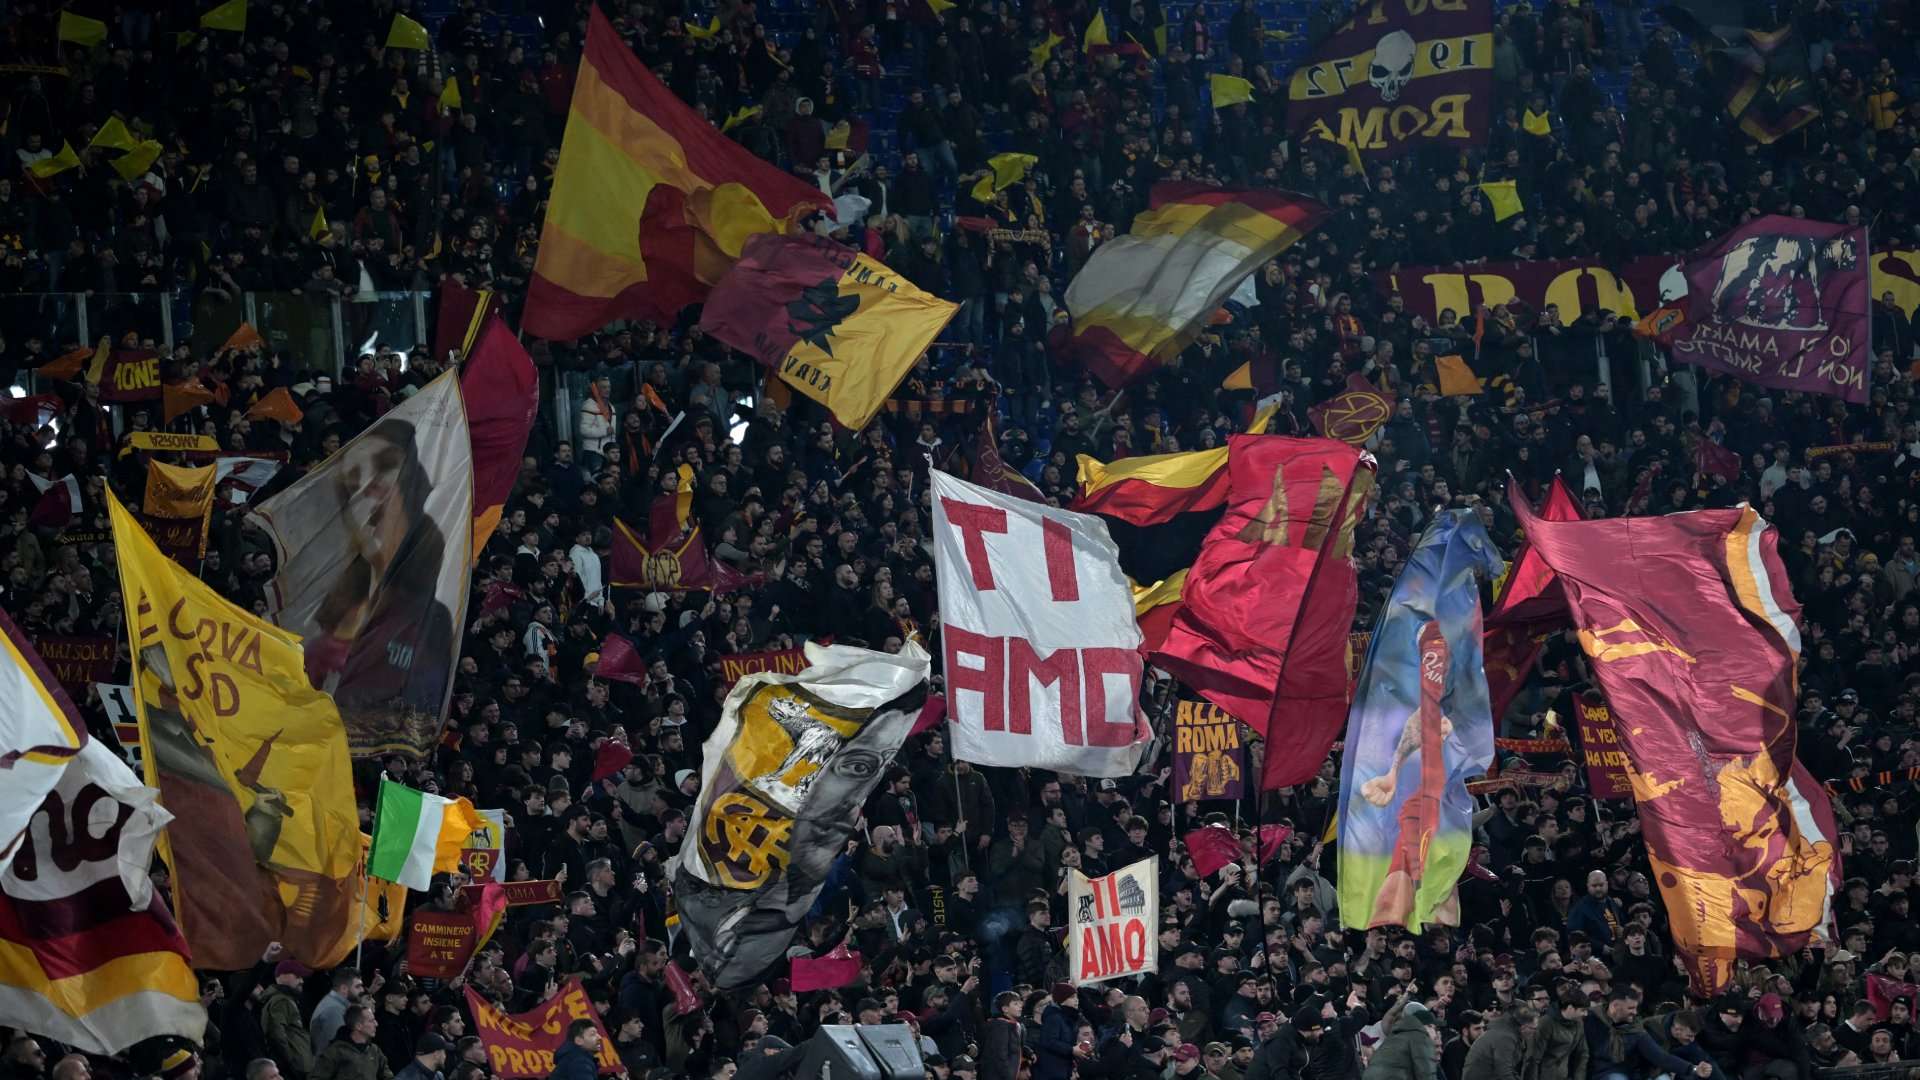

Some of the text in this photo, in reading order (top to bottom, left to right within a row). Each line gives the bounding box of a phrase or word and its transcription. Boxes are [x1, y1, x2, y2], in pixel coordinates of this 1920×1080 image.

[940, 496, 1080, 601] TI
[943, 623, 1148, 747] AMO
[1177, 722, 1240, 753] ROMA
[1087, 872, 1121, 920] TI
[423, 936, 462, 948] INSIEME
[441, 950, 456, 961] TE
[1080, 918, 1146, 981] AMO
